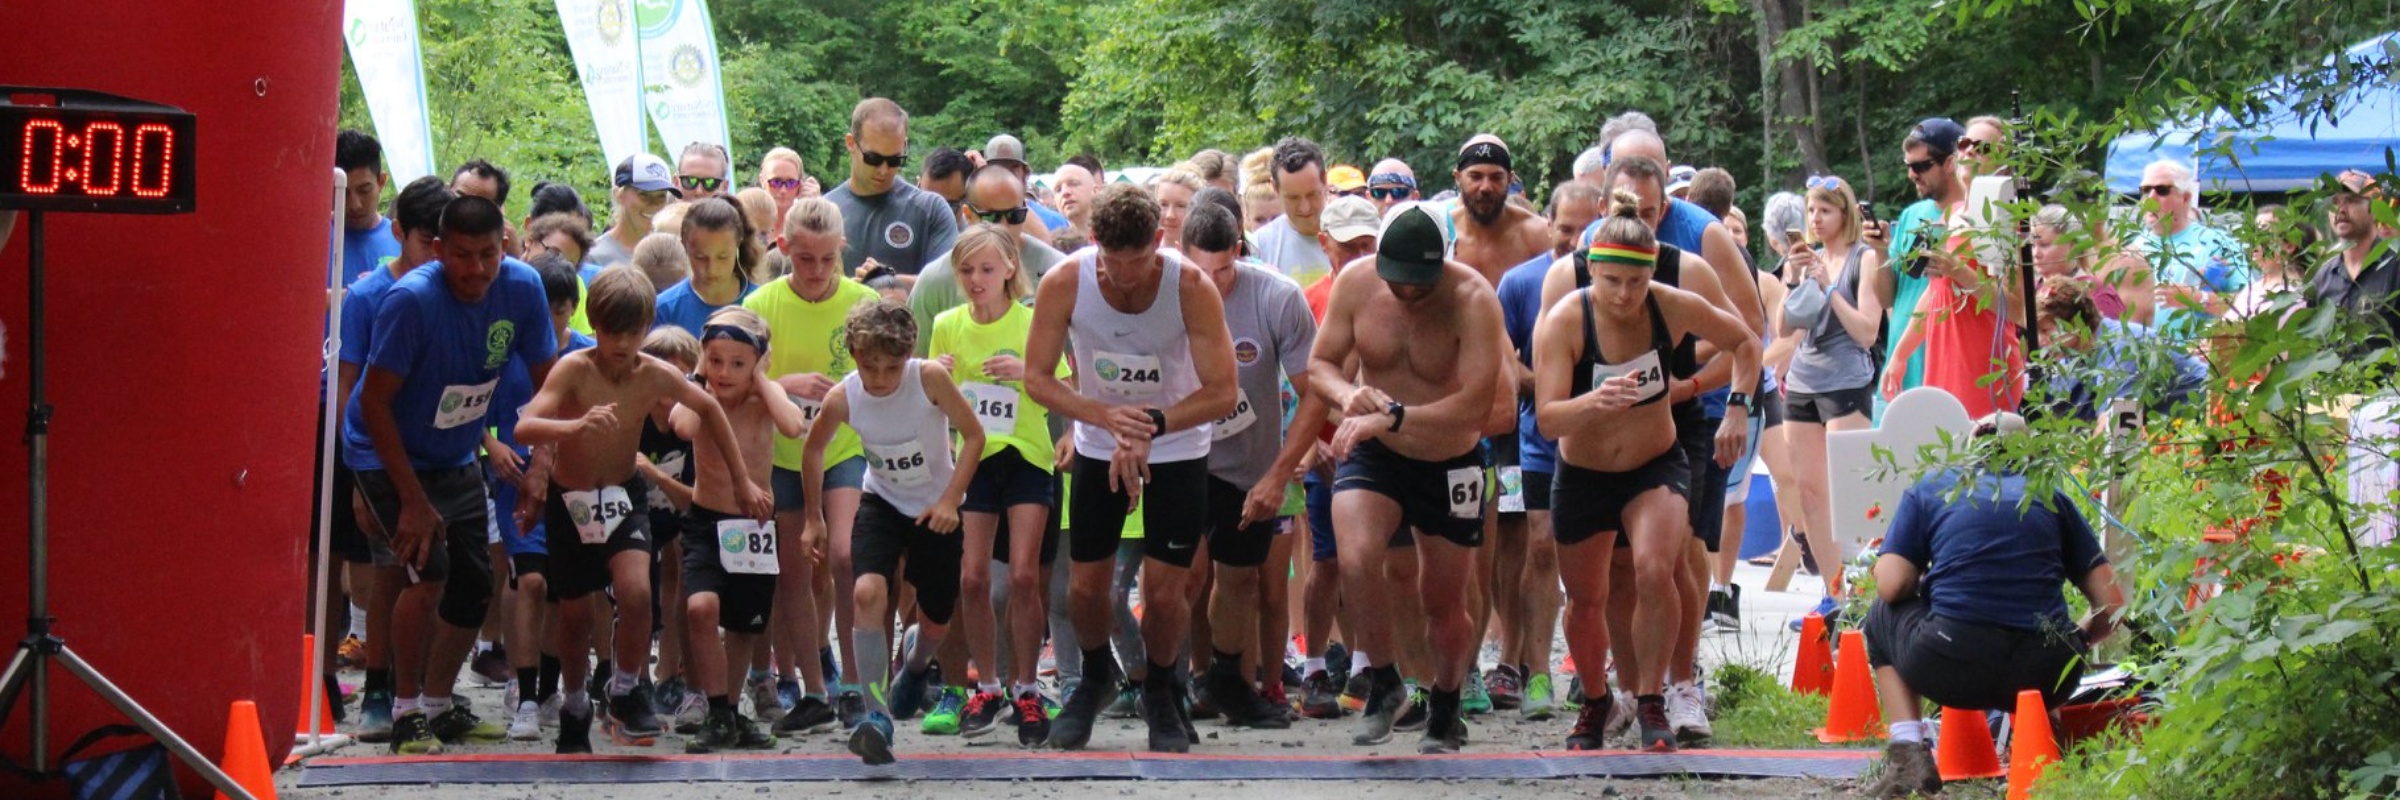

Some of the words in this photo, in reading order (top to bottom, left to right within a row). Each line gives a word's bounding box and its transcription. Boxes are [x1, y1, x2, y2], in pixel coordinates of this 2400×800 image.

[22, 120, 174, 197] 0:00
[1121, 368, 1160, 383] 244
[979, 399, 1014, 419] 161
[885, 451, 924, 471] 166
[1452, 481, 1479, 505] 61
[748, 532, 774, 555] 82
